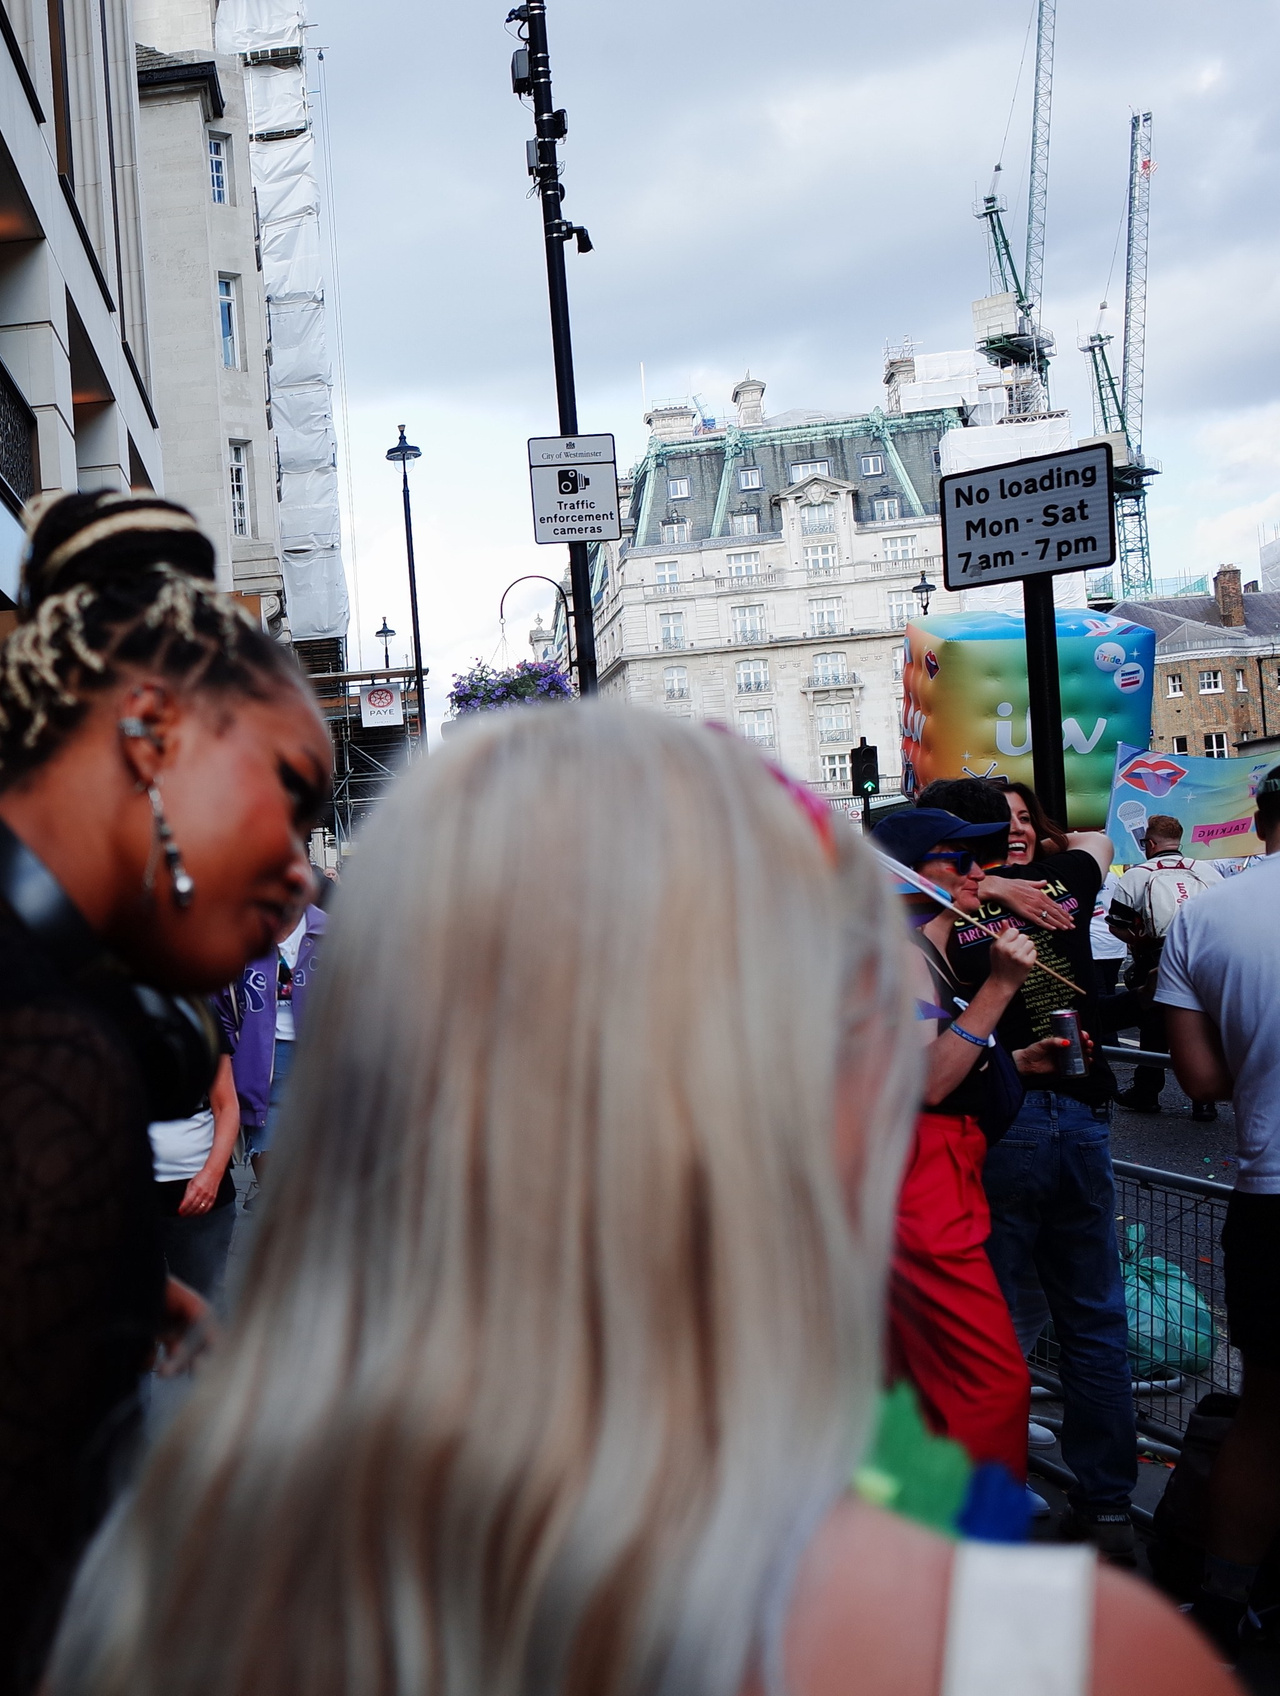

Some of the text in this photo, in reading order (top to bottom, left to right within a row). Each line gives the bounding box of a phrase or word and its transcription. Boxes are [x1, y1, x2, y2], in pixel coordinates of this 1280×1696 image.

[542, 452, 554, 461] City
[564, 450, 602, 459] Westminster
[955, 466, 1096, 508] No loading
[556, 499, 596, 511] Traffic
[539, 511, 615, 524] enforcement
[965, 517, 1019, 541] Mon
[1041, 499, 1089, 527] Sat
[553, 525, 603, 536] cameras
[996, 702, 1107, 756] iv
